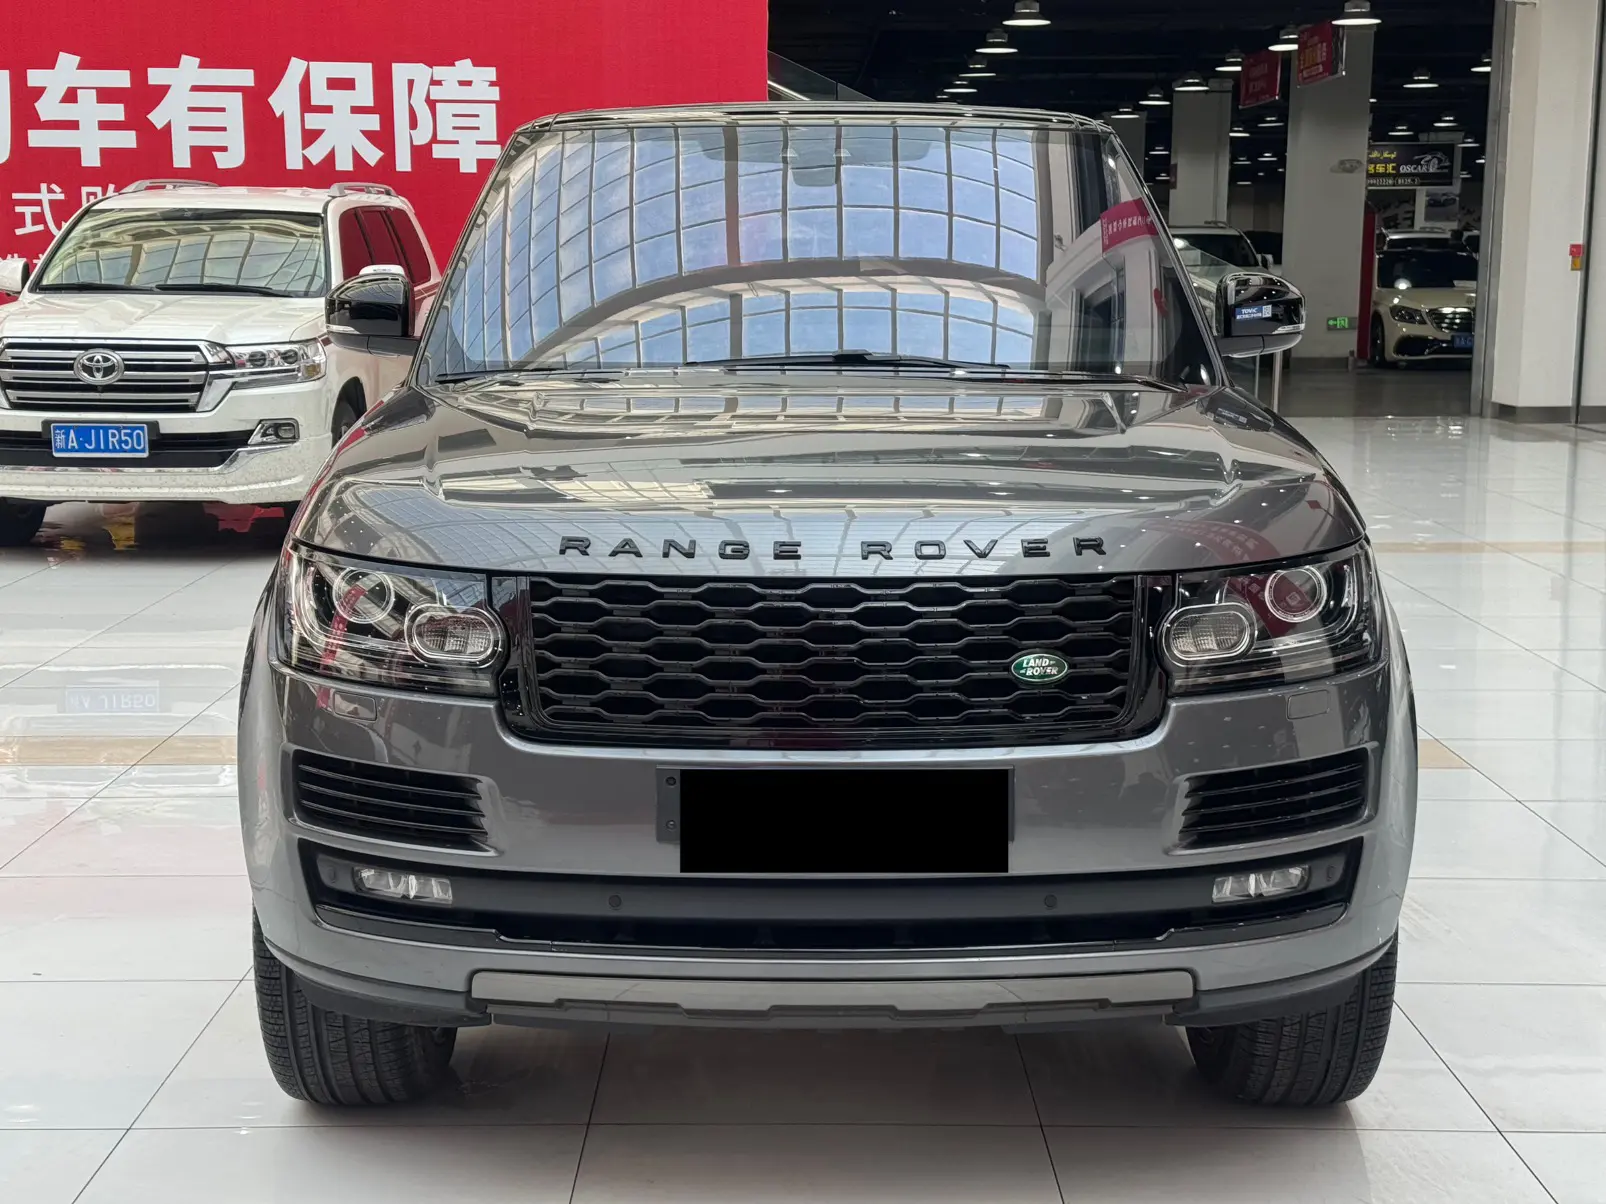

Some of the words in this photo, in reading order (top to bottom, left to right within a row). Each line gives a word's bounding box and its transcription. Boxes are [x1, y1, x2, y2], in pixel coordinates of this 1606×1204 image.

[0, 51, 501, 174] 车有保障
[558, 536, 802, 561] RANGE
[860, 536, 1107, 561] ROVER
[1022, 658, 1049, 668] LAND
[1025, 667, 1059, 676] ROVER
